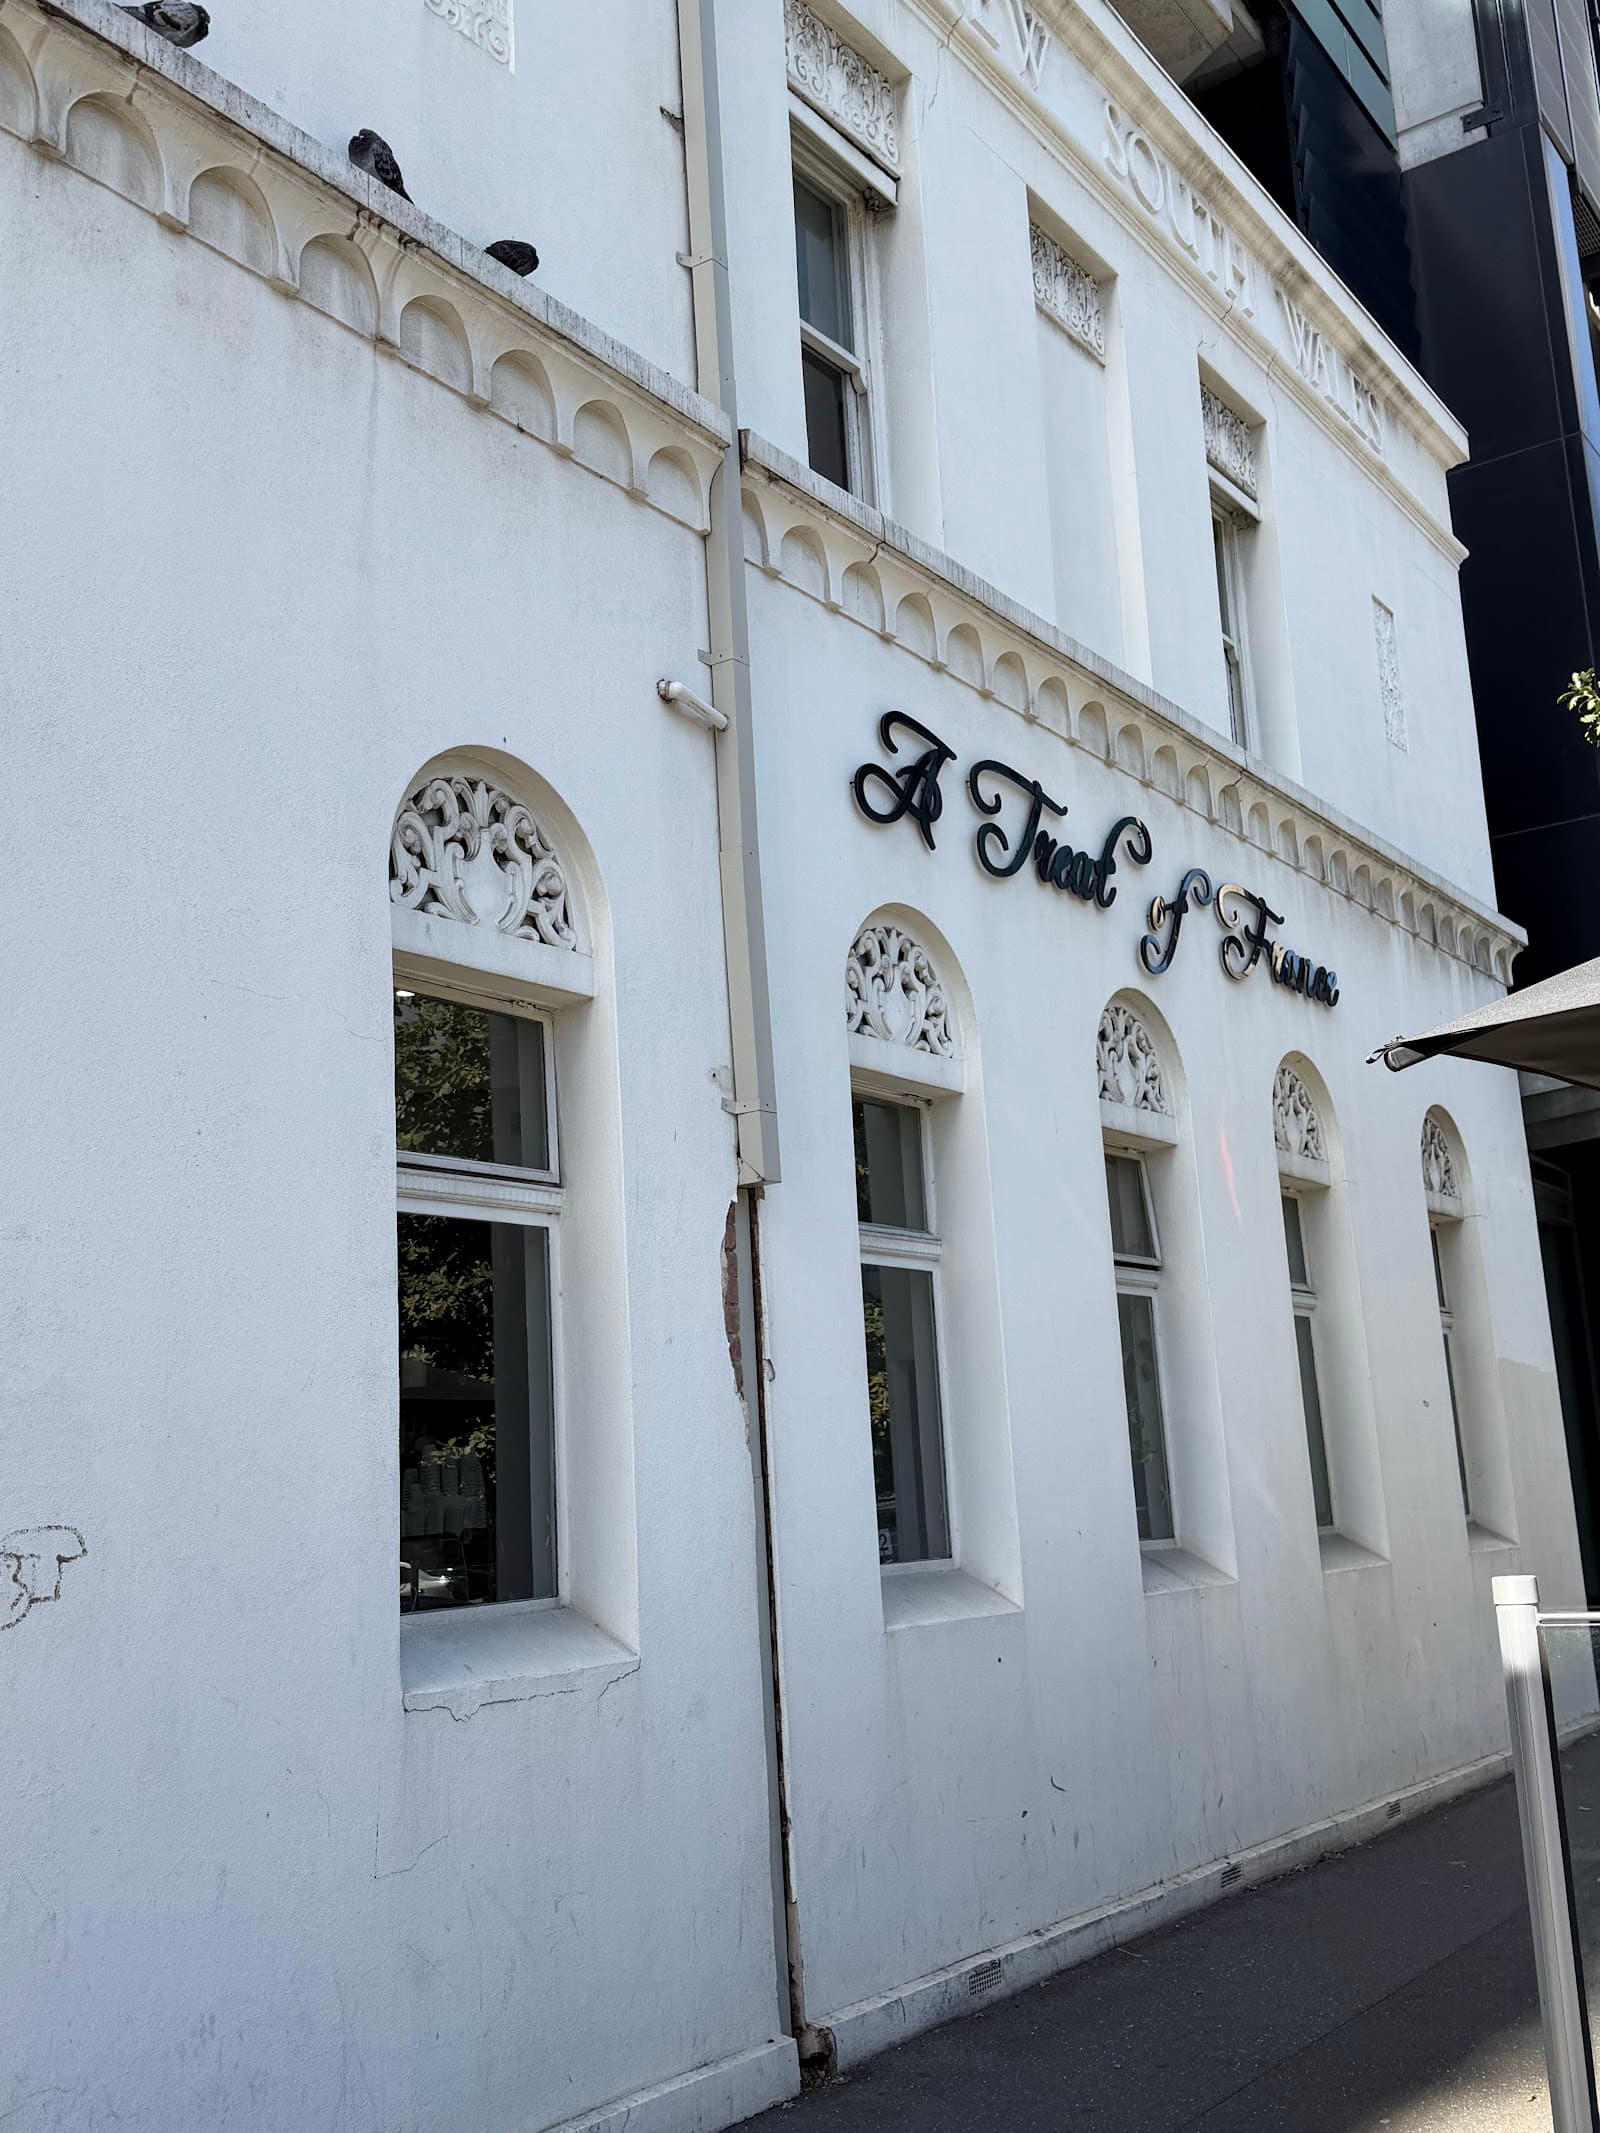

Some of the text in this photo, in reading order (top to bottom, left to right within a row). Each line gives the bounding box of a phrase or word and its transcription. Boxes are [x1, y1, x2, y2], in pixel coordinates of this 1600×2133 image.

[1103, 102, 1255, 319] SOUTH
[1275, 285, 1385, 453] WALES
[854, 710, 1340, 1007] A Treat of France
